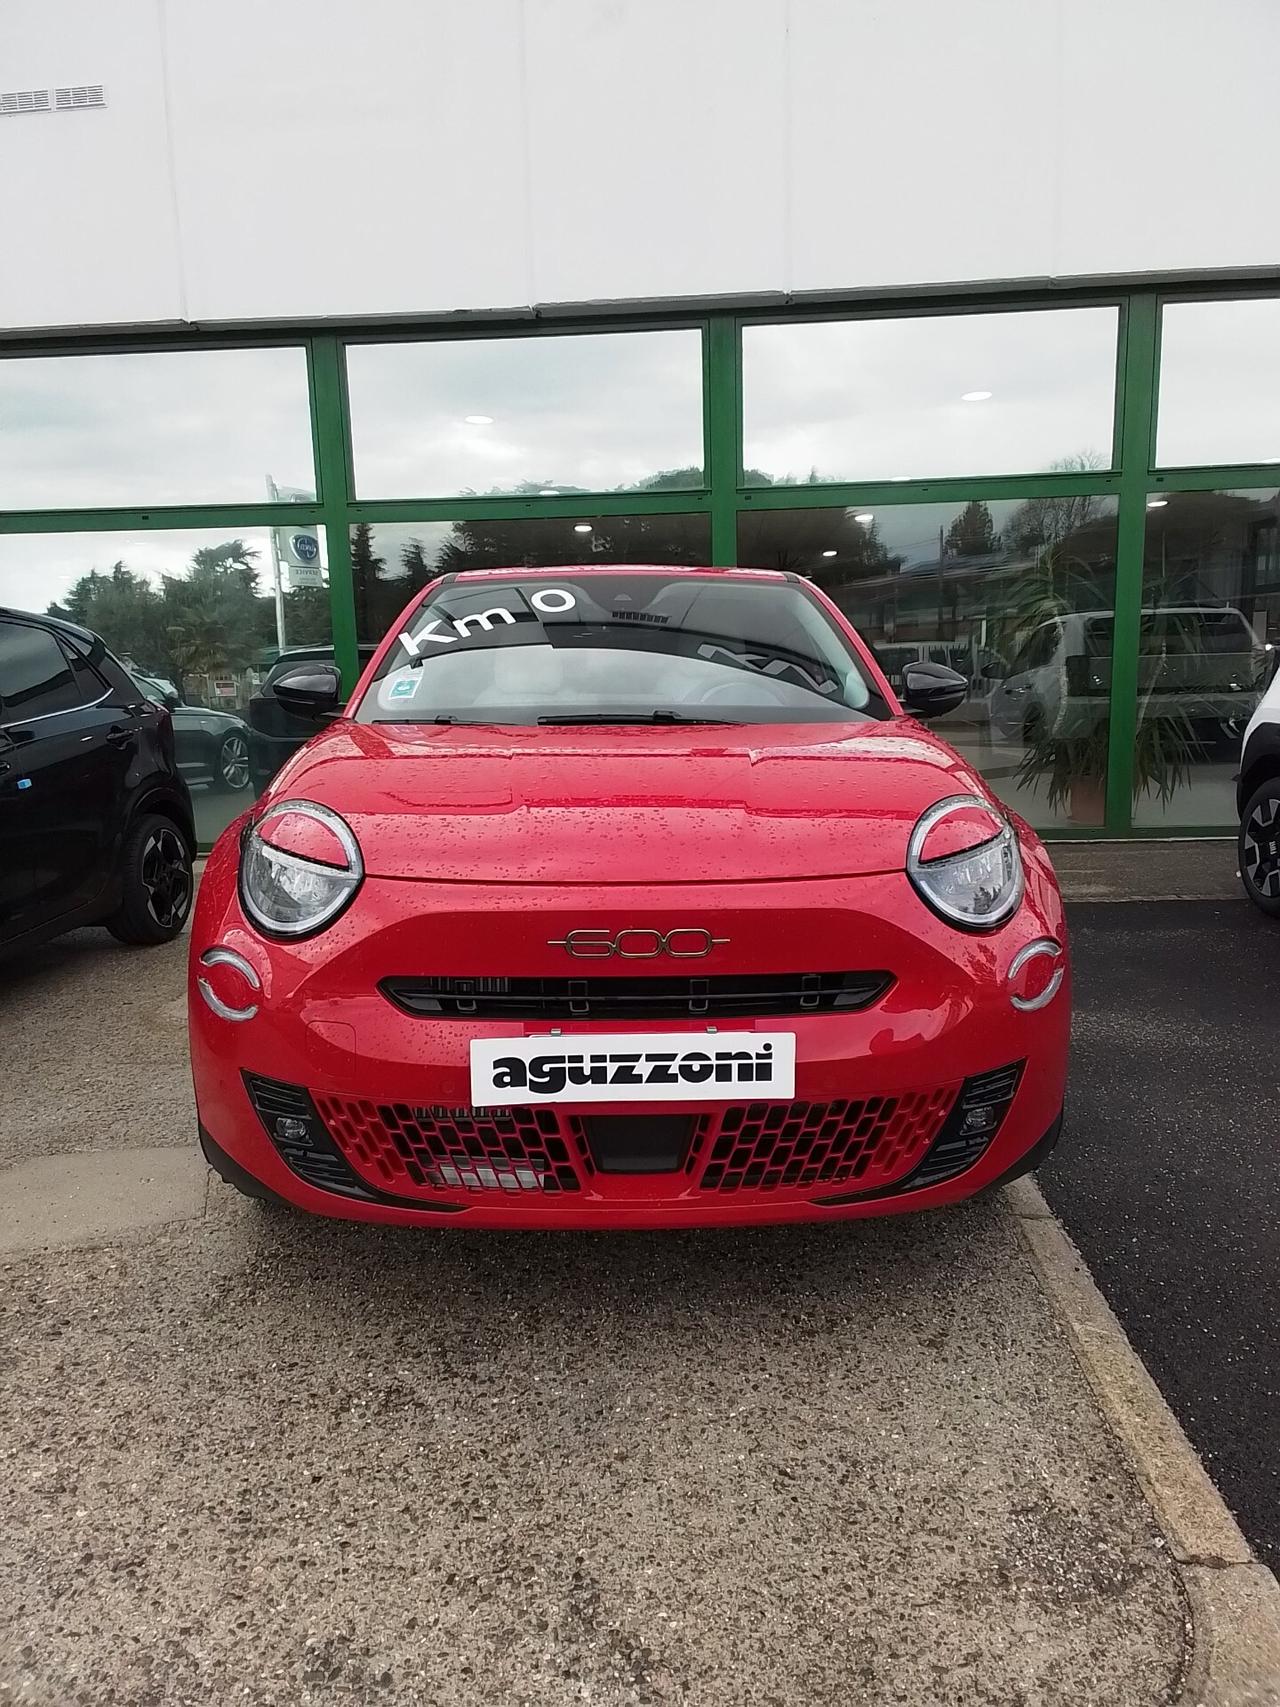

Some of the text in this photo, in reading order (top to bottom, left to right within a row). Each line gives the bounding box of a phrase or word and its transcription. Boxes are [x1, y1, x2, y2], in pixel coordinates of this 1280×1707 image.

[398, 607, 516, 656] Km
[565, 928, 713, 958] 600
[492, 1042, 773, 1095] aguzzoni
